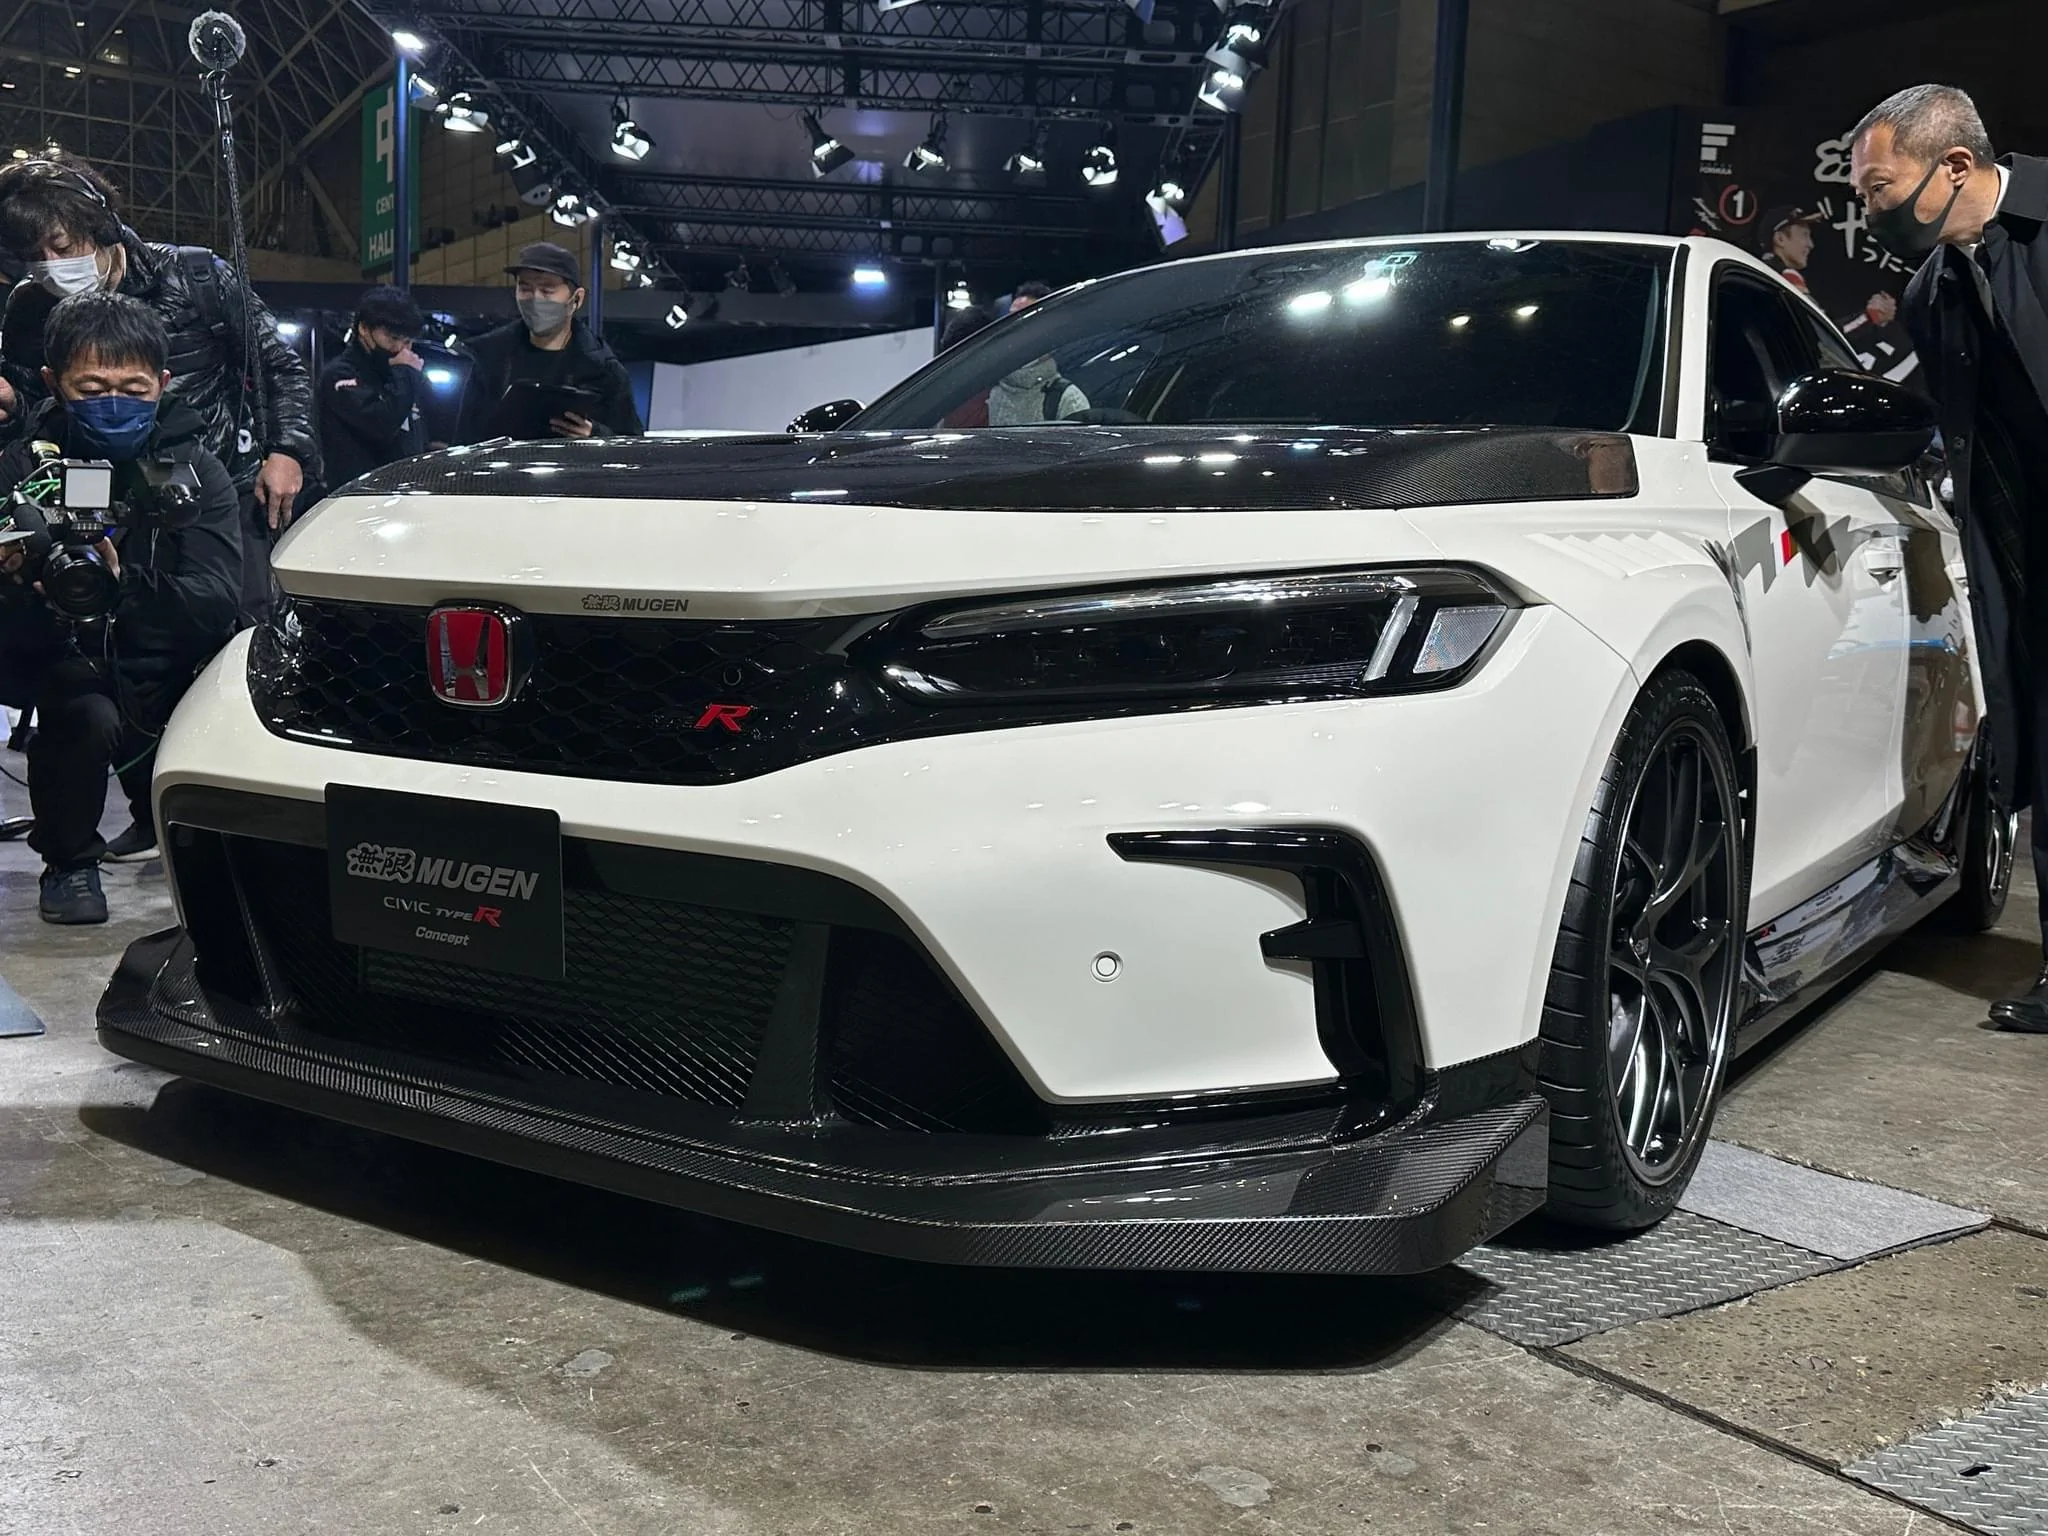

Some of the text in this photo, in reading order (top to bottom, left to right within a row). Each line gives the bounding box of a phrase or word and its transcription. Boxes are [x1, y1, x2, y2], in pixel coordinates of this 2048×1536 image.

[376, 194, 394, 216] CENT
[622, 598, 690, 612] MUGEN
[346, 842, 540, 901] 無限 MUGEN
[383, 895, 432, 915] CIVIC
[415, 925, 470, 946] Concept
